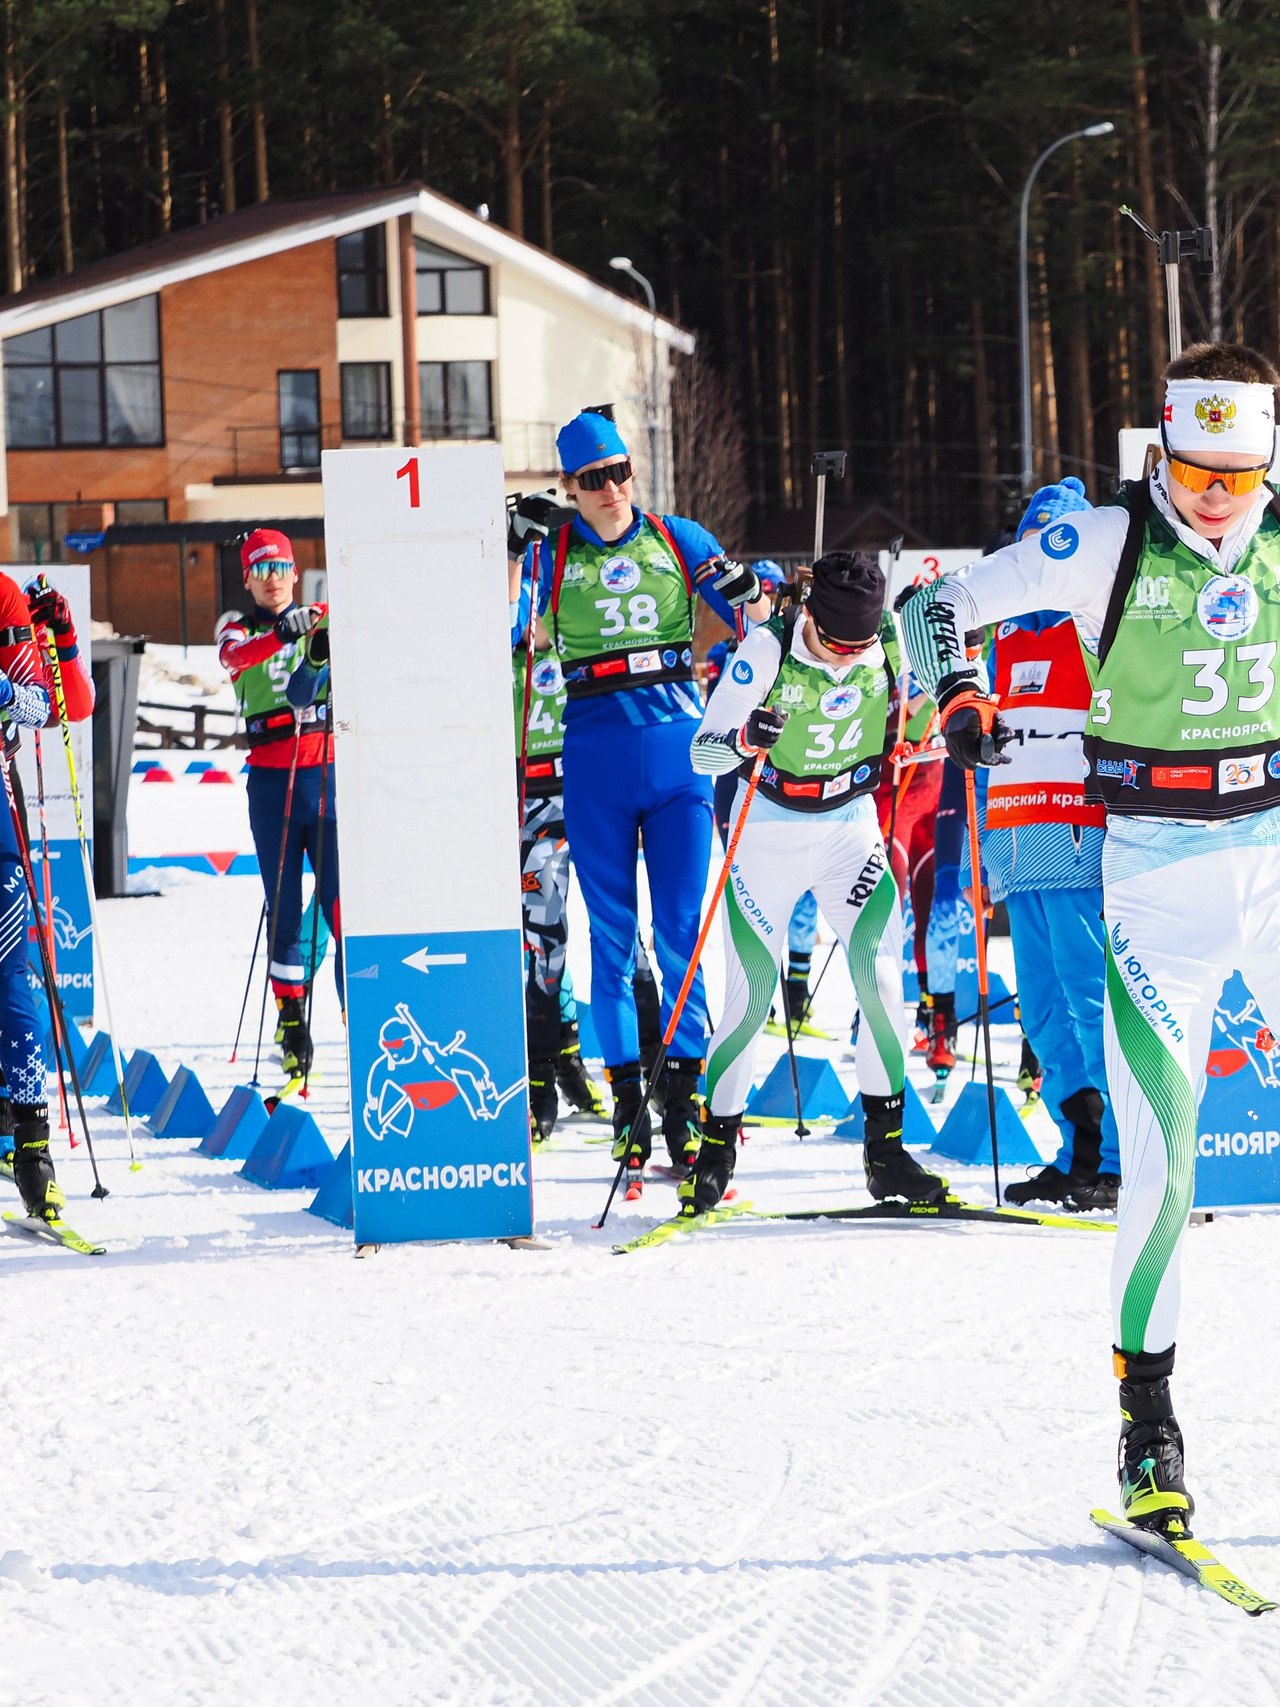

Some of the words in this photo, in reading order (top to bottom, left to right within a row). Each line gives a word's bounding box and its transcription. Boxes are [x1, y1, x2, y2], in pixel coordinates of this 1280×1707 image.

[396, 458, 421, 508] 1
[924, 557, 940, 584] 3
[594, 594, 660, 637] 38
[602, 635, 660, 650] КРАСНОЯРСК
[1181, 641, 1279, 717] 33
[805, 718, 863, 759] 34
[1181, 719, 1274, 741] КРАСНОЯРСК
[803, 752, 859, 771] КРАСНОРСК
[1052, 793, 1096, 808] кра
[735, 876, 774, 936] ЮГОРИЯ
[1118, 965, 1160, 1029] СТРАХОВАНИЕ
[1123, 955, 1185, 1043] ЮГОРИЯ
[357, 1161, 527, 1194] КРАСНОЯРСК
[909, 1206, 939, 1214] FISCHER
